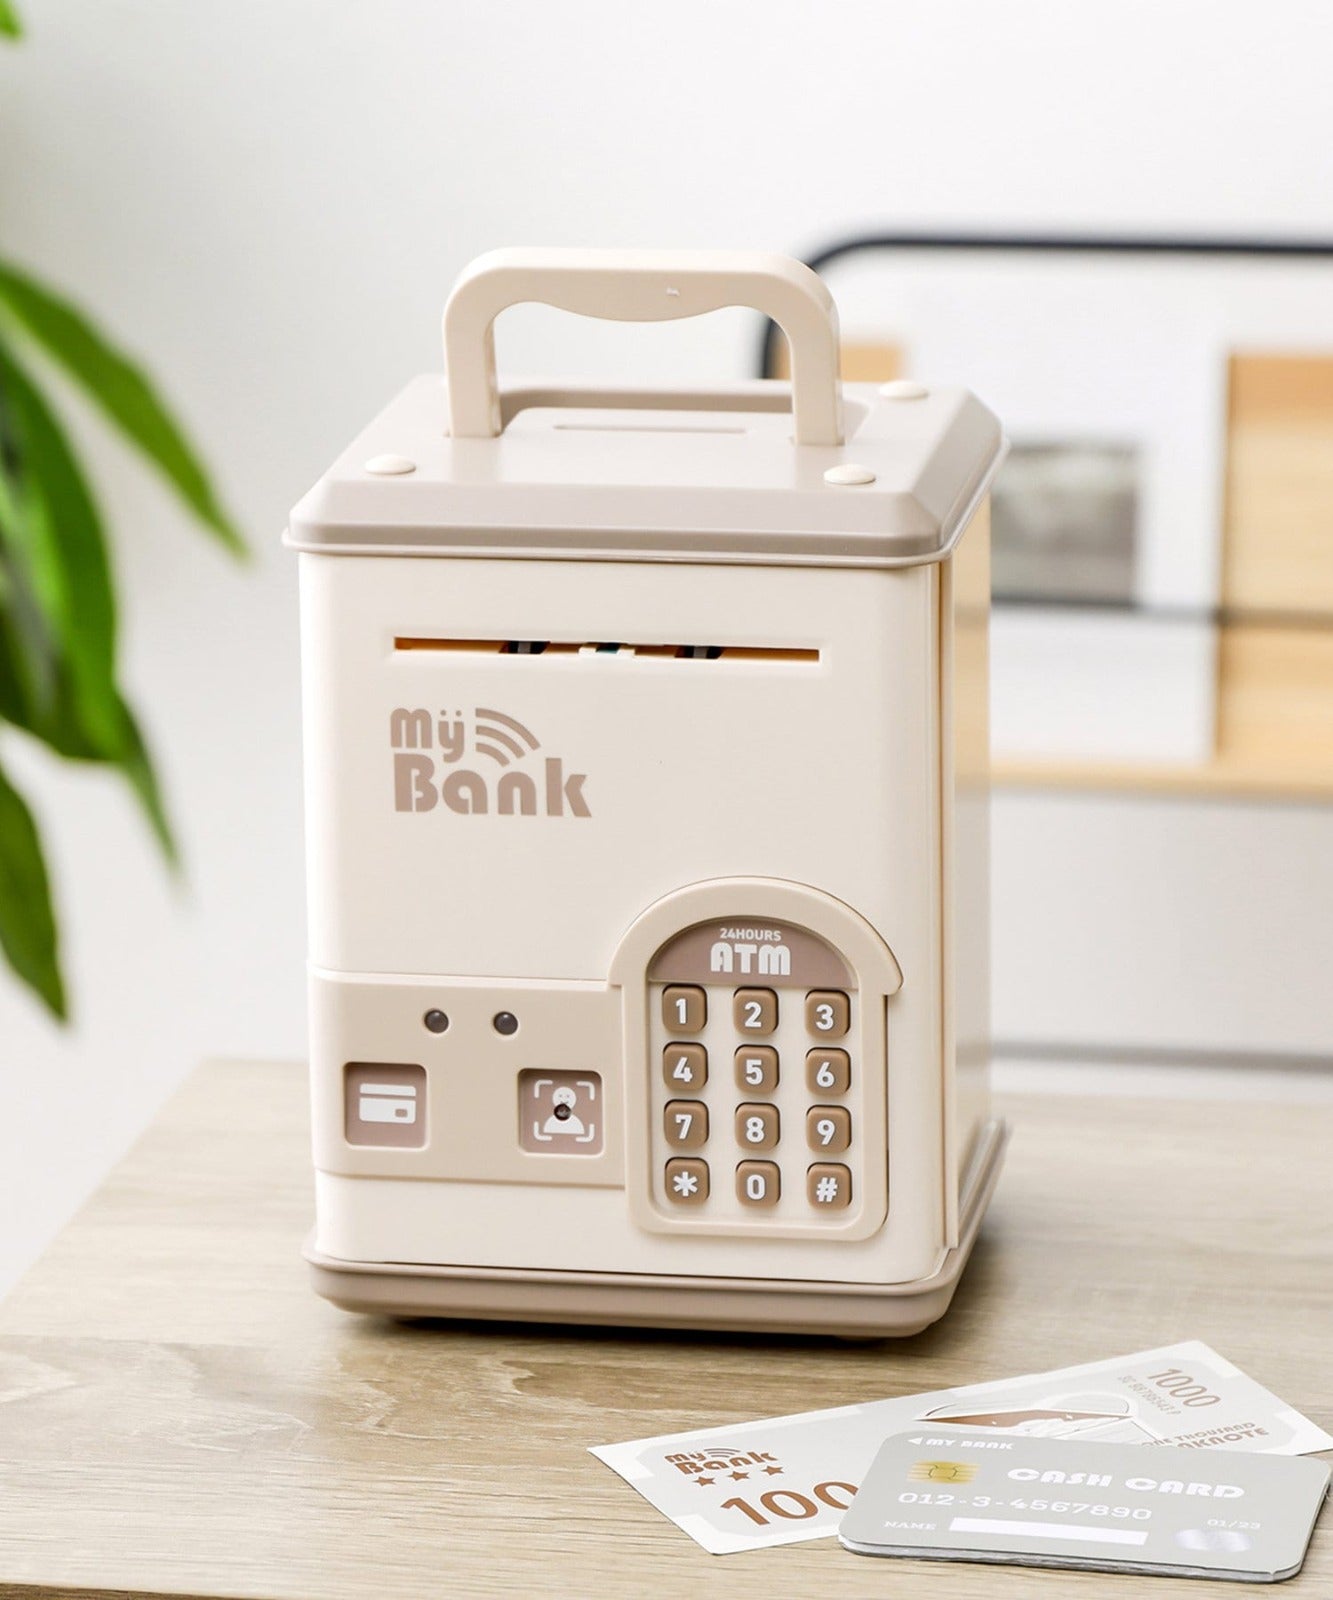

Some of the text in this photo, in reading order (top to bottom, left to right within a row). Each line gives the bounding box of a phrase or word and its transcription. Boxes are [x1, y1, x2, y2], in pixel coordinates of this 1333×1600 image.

[394, 753, 592, 818] Bank
[720, 928, 781, 942] 24HOURS
[711, 942, 790, 976] ATM
[675, 998, 834, 1030] 1 2 3
[673, 1057, 835, 1088] 4 5 6
[675, 1114, 835, 1145] 7 8 9
[746, 1174, 765, 1200] 0
[816, 1177, 838, 1203] #
[1148, 1368, 1221, 1408] 1000
[926, 1438, 1014, 1450] MY BANK
[674, 1451, 778, 1475] Bank
[1007, 1468, 1245, 1499] CASH CARD
[883, 1520, 937, 1530] NAME
[1207, 1519, 1261, 1530] 01/23
